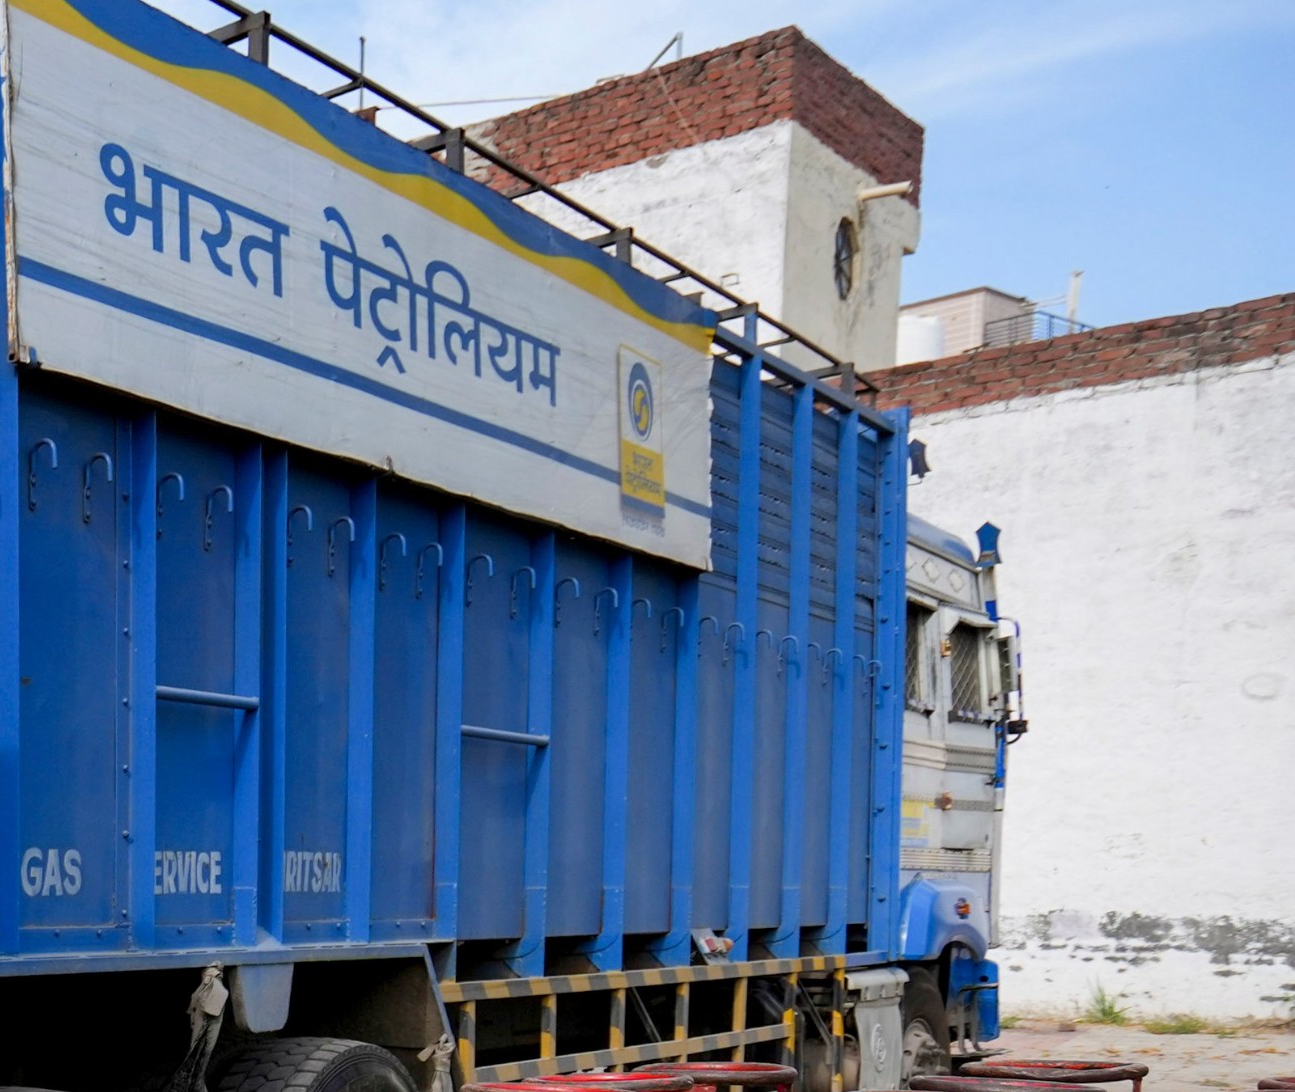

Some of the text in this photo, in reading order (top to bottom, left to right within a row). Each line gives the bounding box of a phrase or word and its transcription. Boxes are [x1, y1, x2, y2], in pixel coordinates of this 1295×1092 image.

[99, 143, 560, 407] भारत पेट्रोलियम
[21, 846, 82, 897] GAS
[154, 850, 222, 895] ERVICE
[283, 850, 343, 894] RITSAR
